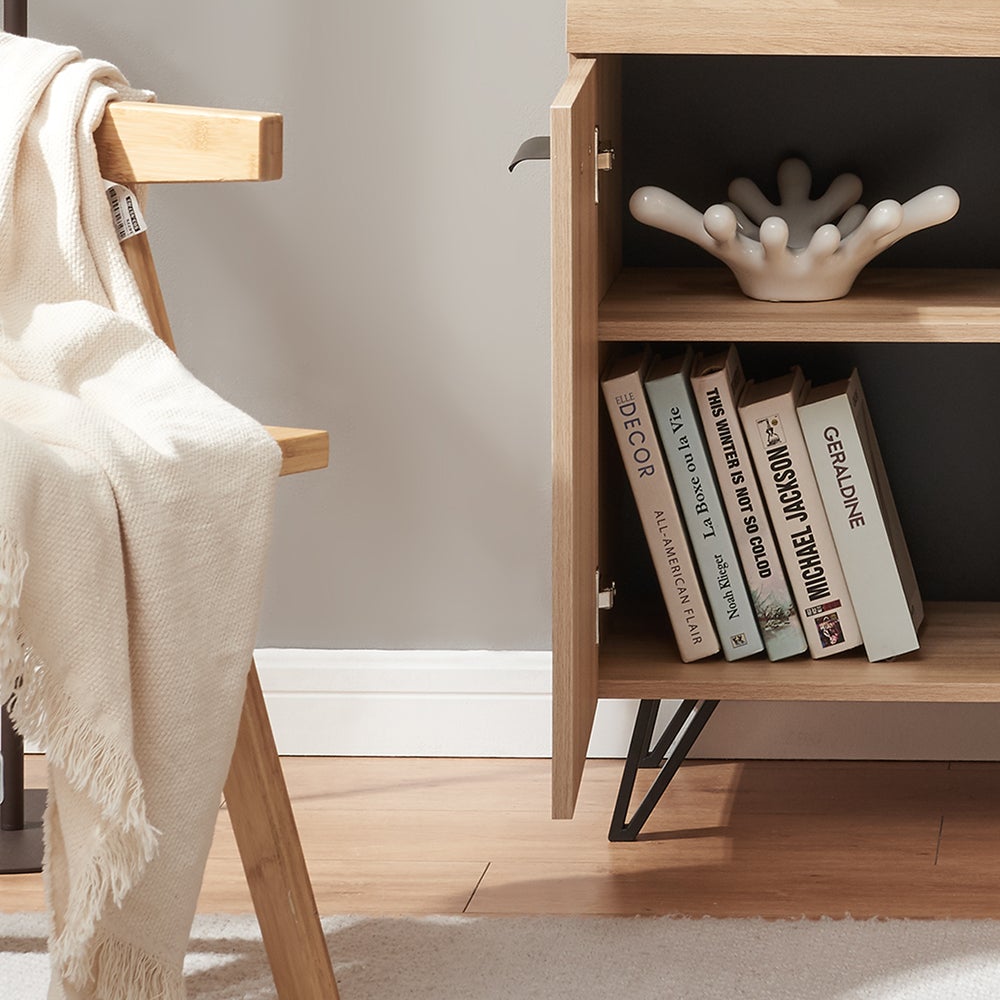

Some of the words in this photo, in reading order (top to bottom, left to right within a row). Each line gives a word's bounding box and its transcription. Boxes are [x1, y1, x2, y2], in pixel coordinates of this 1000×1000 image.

[615, 392, 635, 405] ELLE
[706, 387, 725, 418] THIS
[669, 406, 684, 434] Vie
[619, 402, 655, 478] DECOR
[678, 435, 691, 451] la
[715, 419, 740, 470] WINTER
[684, 453, 697, 473] ou
[730, 470, 745, 485] IS
[823, 426, 866, 530] GERALDINE
[691, 476, 709, 515] Boxe
[766, 445, 809, 521] JACKSON
[735, 486, 754, 514] NOT
[702, 517, 717, 540] La
[743, 515, 760, 534] SO
[750, 535, 772, 580] COLOD
[790, 524, 831, 602] MICHAEL
[654, 510, 690, 604] ALL-AMERICAN
[684, 608, 703, 645] FLAIR
[722, 590, 740, 620] Noah
